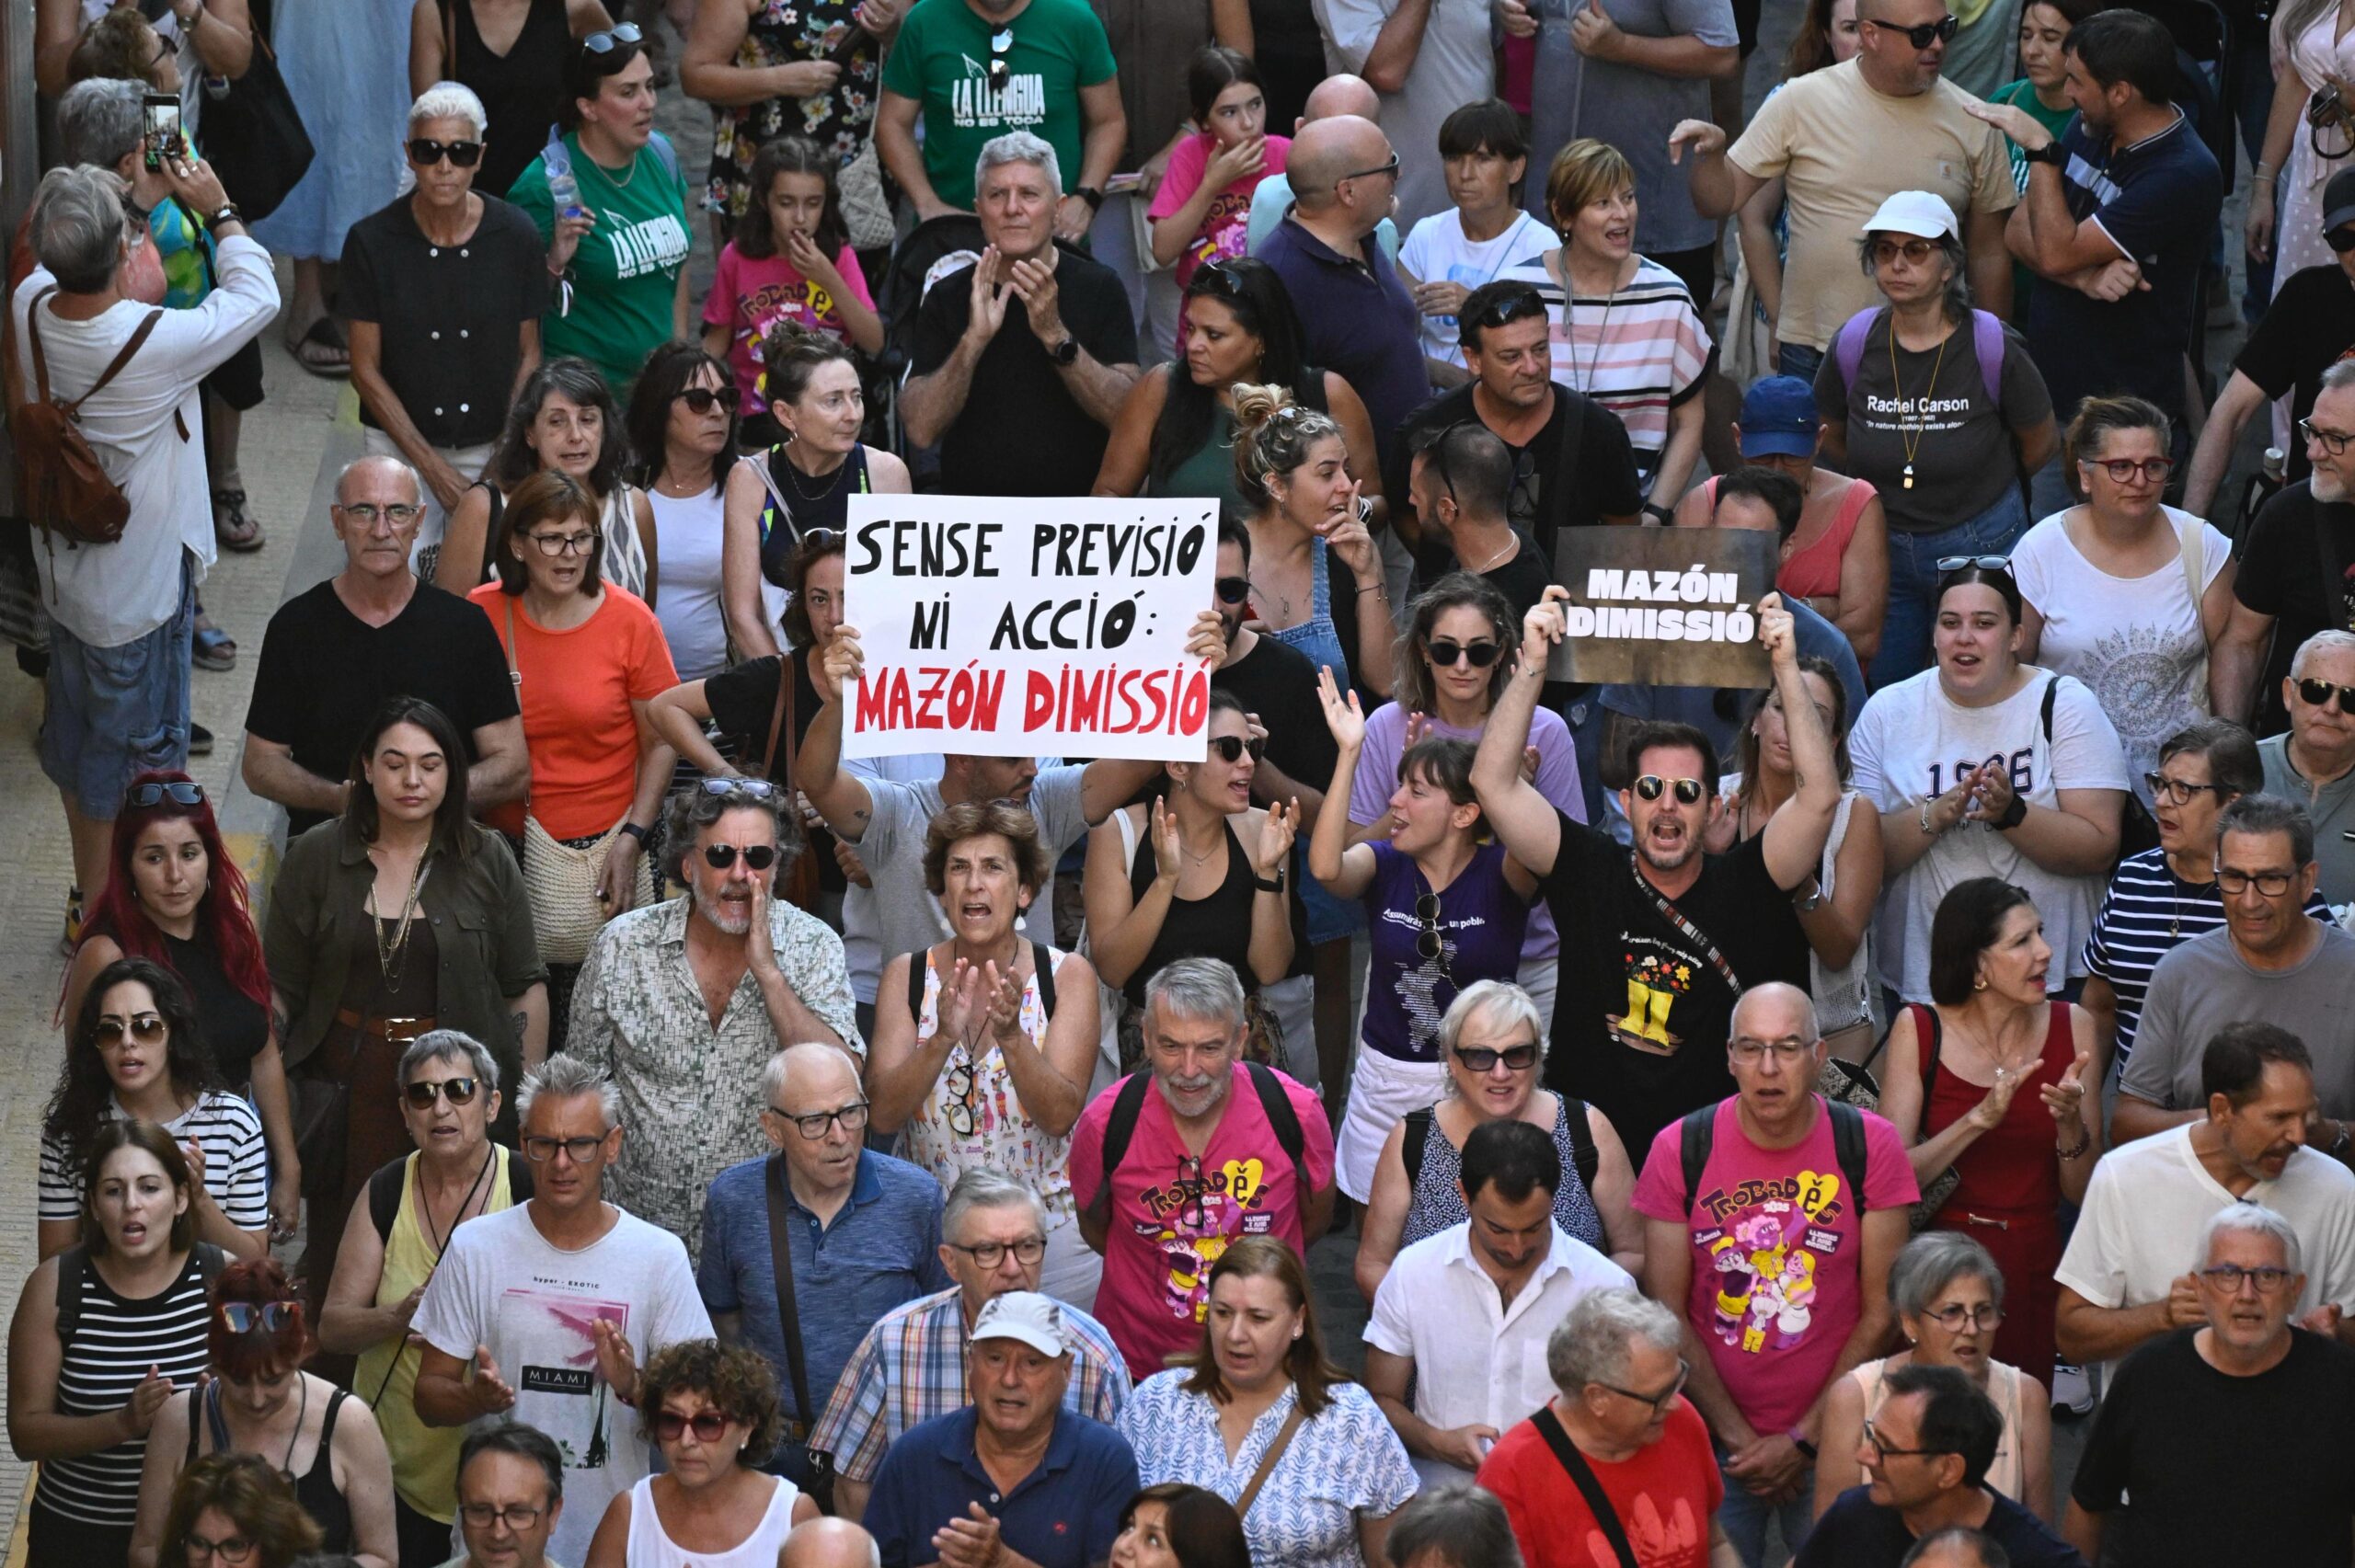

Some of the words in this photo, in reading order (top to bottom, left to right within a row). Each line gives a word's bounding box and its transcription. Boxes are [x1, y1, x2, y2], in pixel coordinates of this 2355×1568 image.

[952, 78, 973, 118] LA
[954, 119, 975, 127] NO
[1003, 116, 1044, 125] TOCA
[607, 230, 636, 270] LA
[1867, 395, 1914, 413] Rachel
[1919, 397, 1969, 413] Carson
[850, 520, 1003, 578] SENSE
[1031, 511, 1212, 578] PREVISIÓ
[1587, 564, 1738, 604] MAZÓN
[909, 591, 950, 651] NI
[989, 589, 1157, 651] ACCIÓ:
[1567, 603, 1755, 644] DIMISSIÓ
[855, 658, 1005, 734] MAZÓN
[1023, 657, 1212, 737] DIMISSIÓ
[534, 1276, 557, 1285] hyper
[568, 1280, 601, 1289] EXOTIC
[529, 1369, 587, 1385] MIAMI
